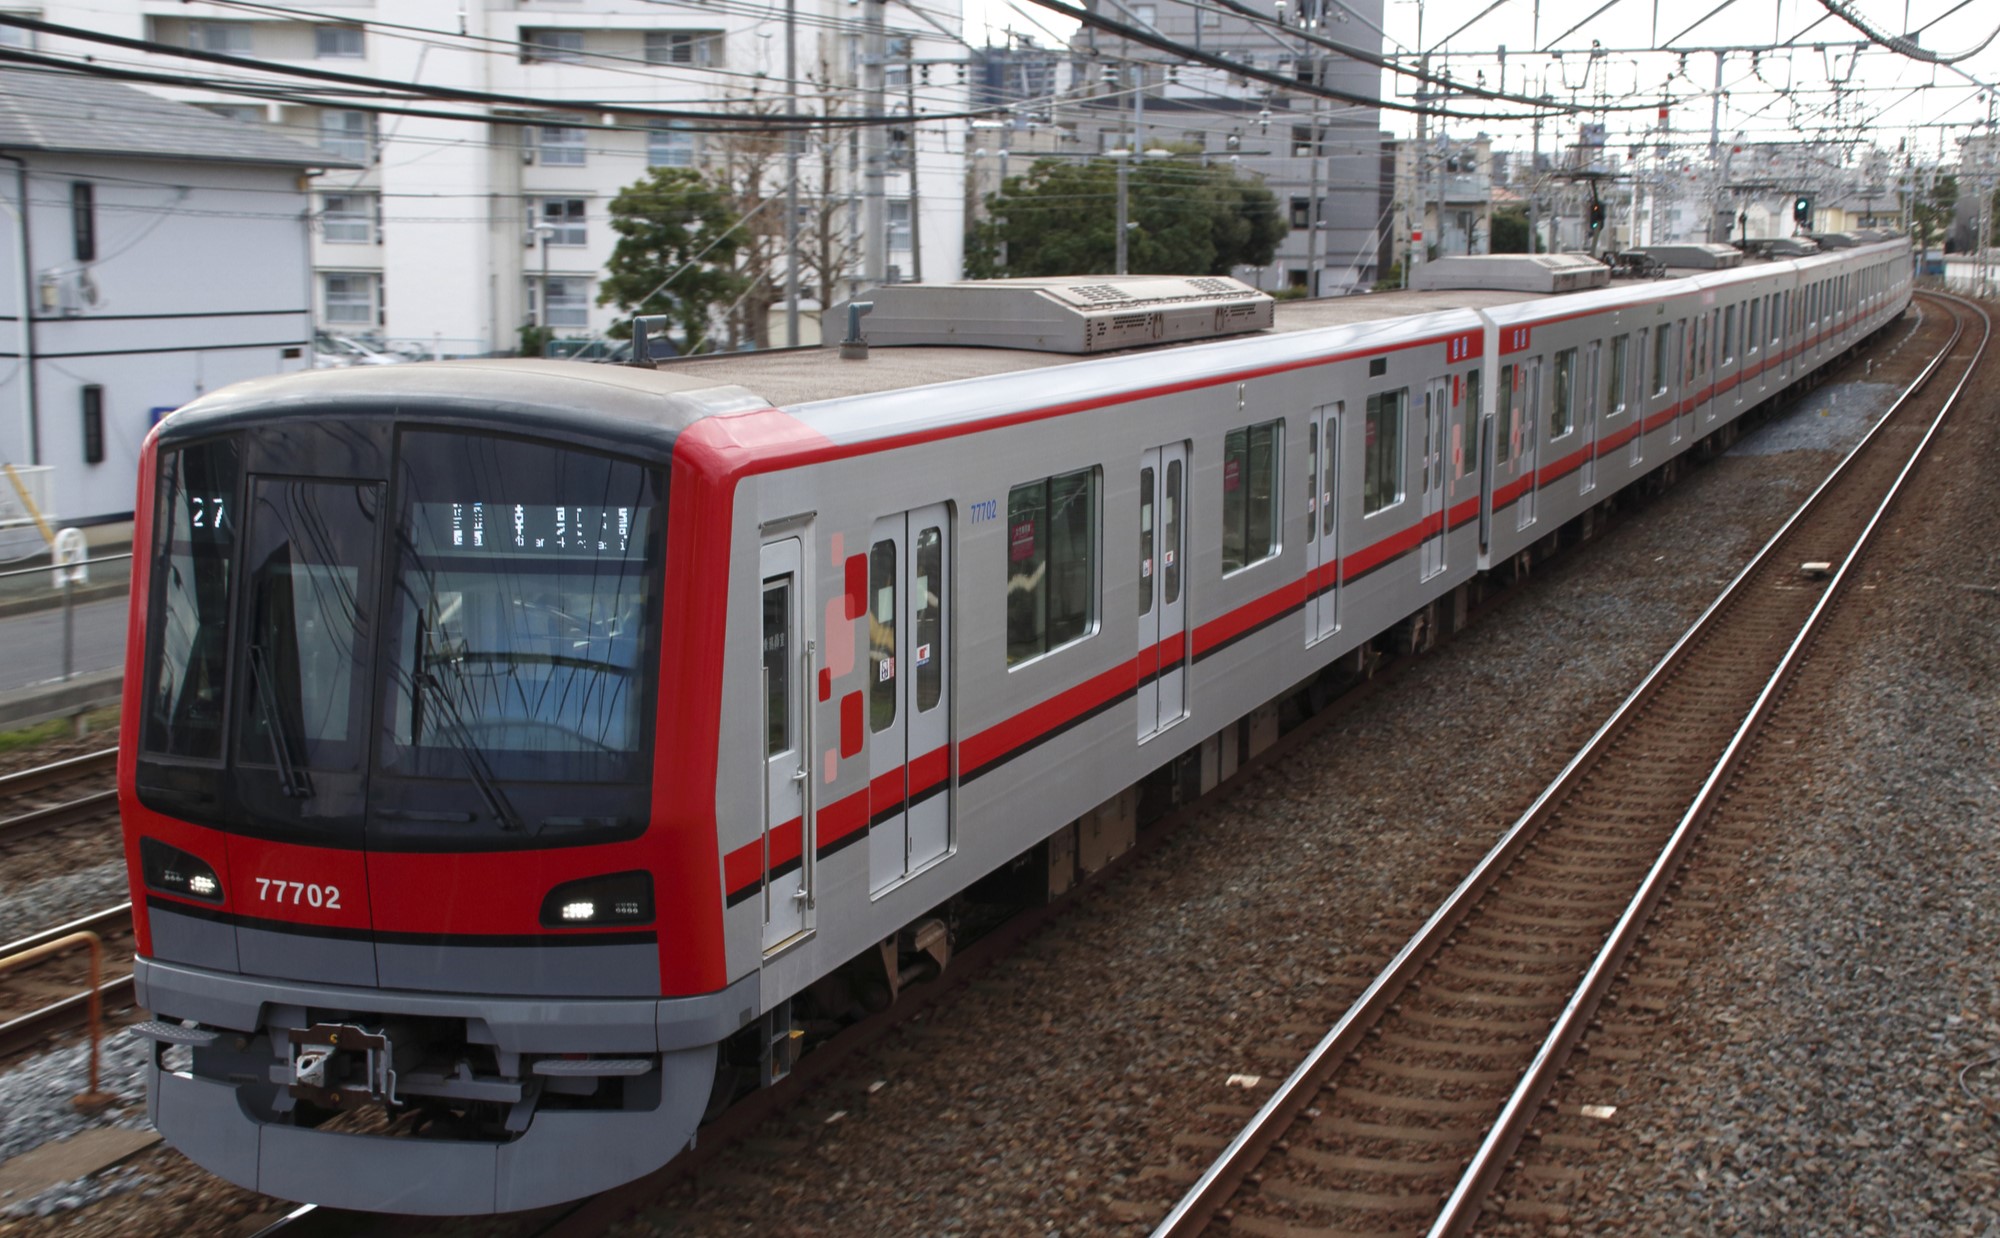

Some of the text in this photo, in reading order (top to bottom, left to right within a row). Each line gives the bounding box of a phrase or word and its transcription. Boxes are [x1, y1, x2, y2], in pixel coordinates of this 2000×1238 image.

[192, 497, 223, 528] 27
[971, 499, 997, 525] 77702
[255, 877, 341, 910] 77702
